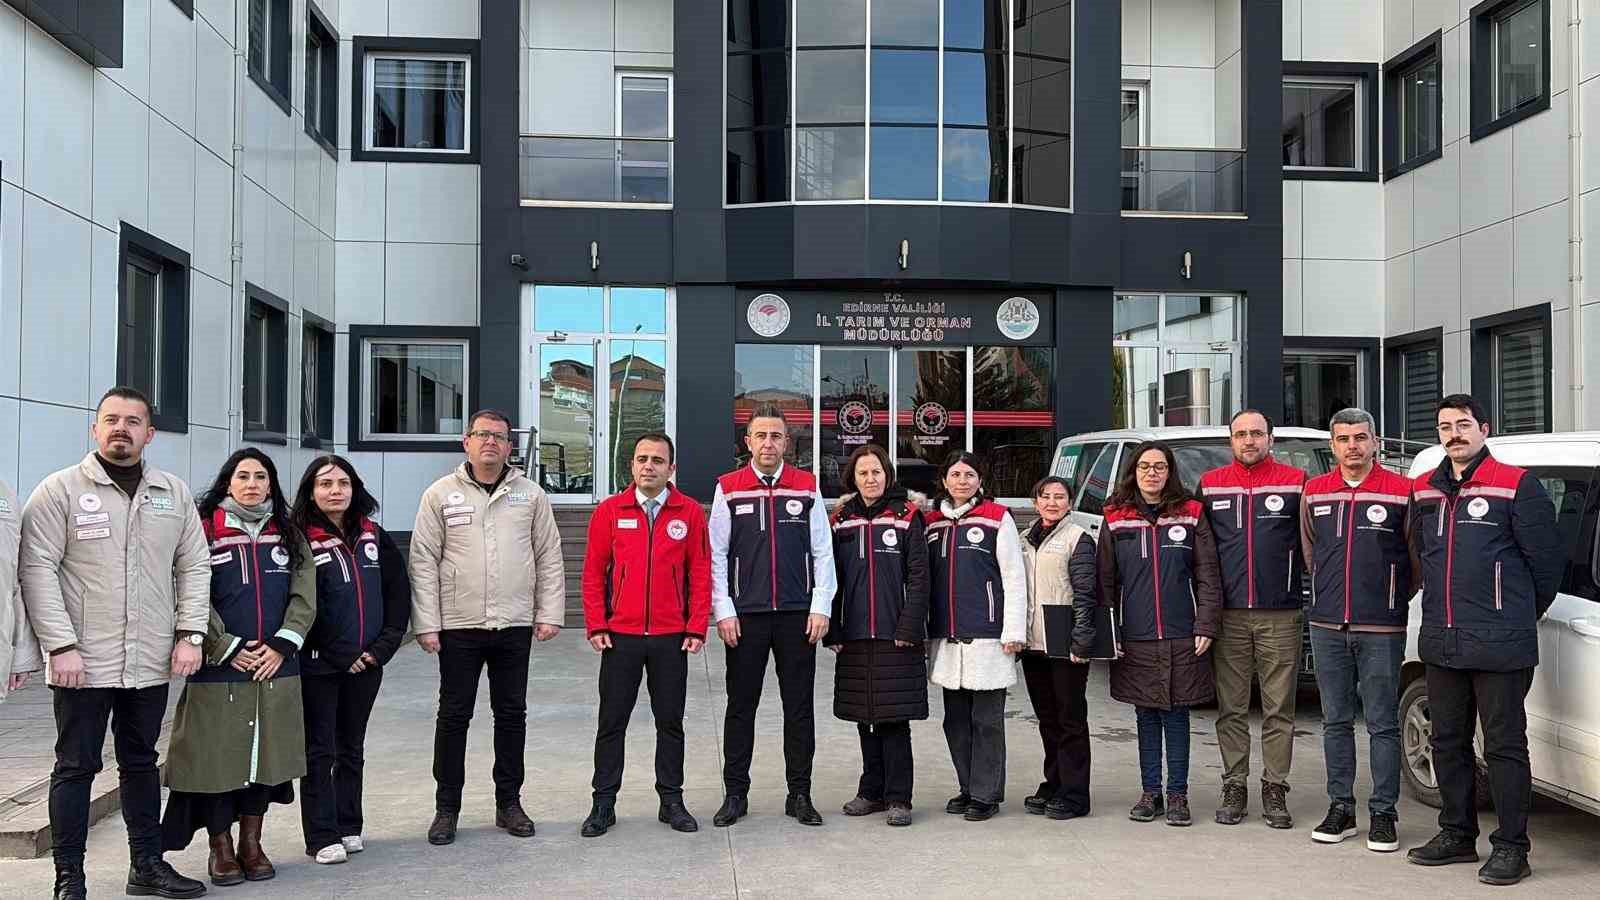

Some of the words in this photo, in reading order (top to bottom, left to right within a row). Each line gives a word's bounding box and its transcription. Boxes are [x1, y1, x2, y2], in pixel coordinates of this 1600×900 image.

[843, 302, 889, 313] EDİRNE
[816, 313, 832, 327] İL
[836, 316, 885, 328] TARIM
[890, 316, 910, 328] VE
[914, 317, 971, 329] ORMAN
[843, 328, 944, 342] MÜDÜRLÜĞÜ
